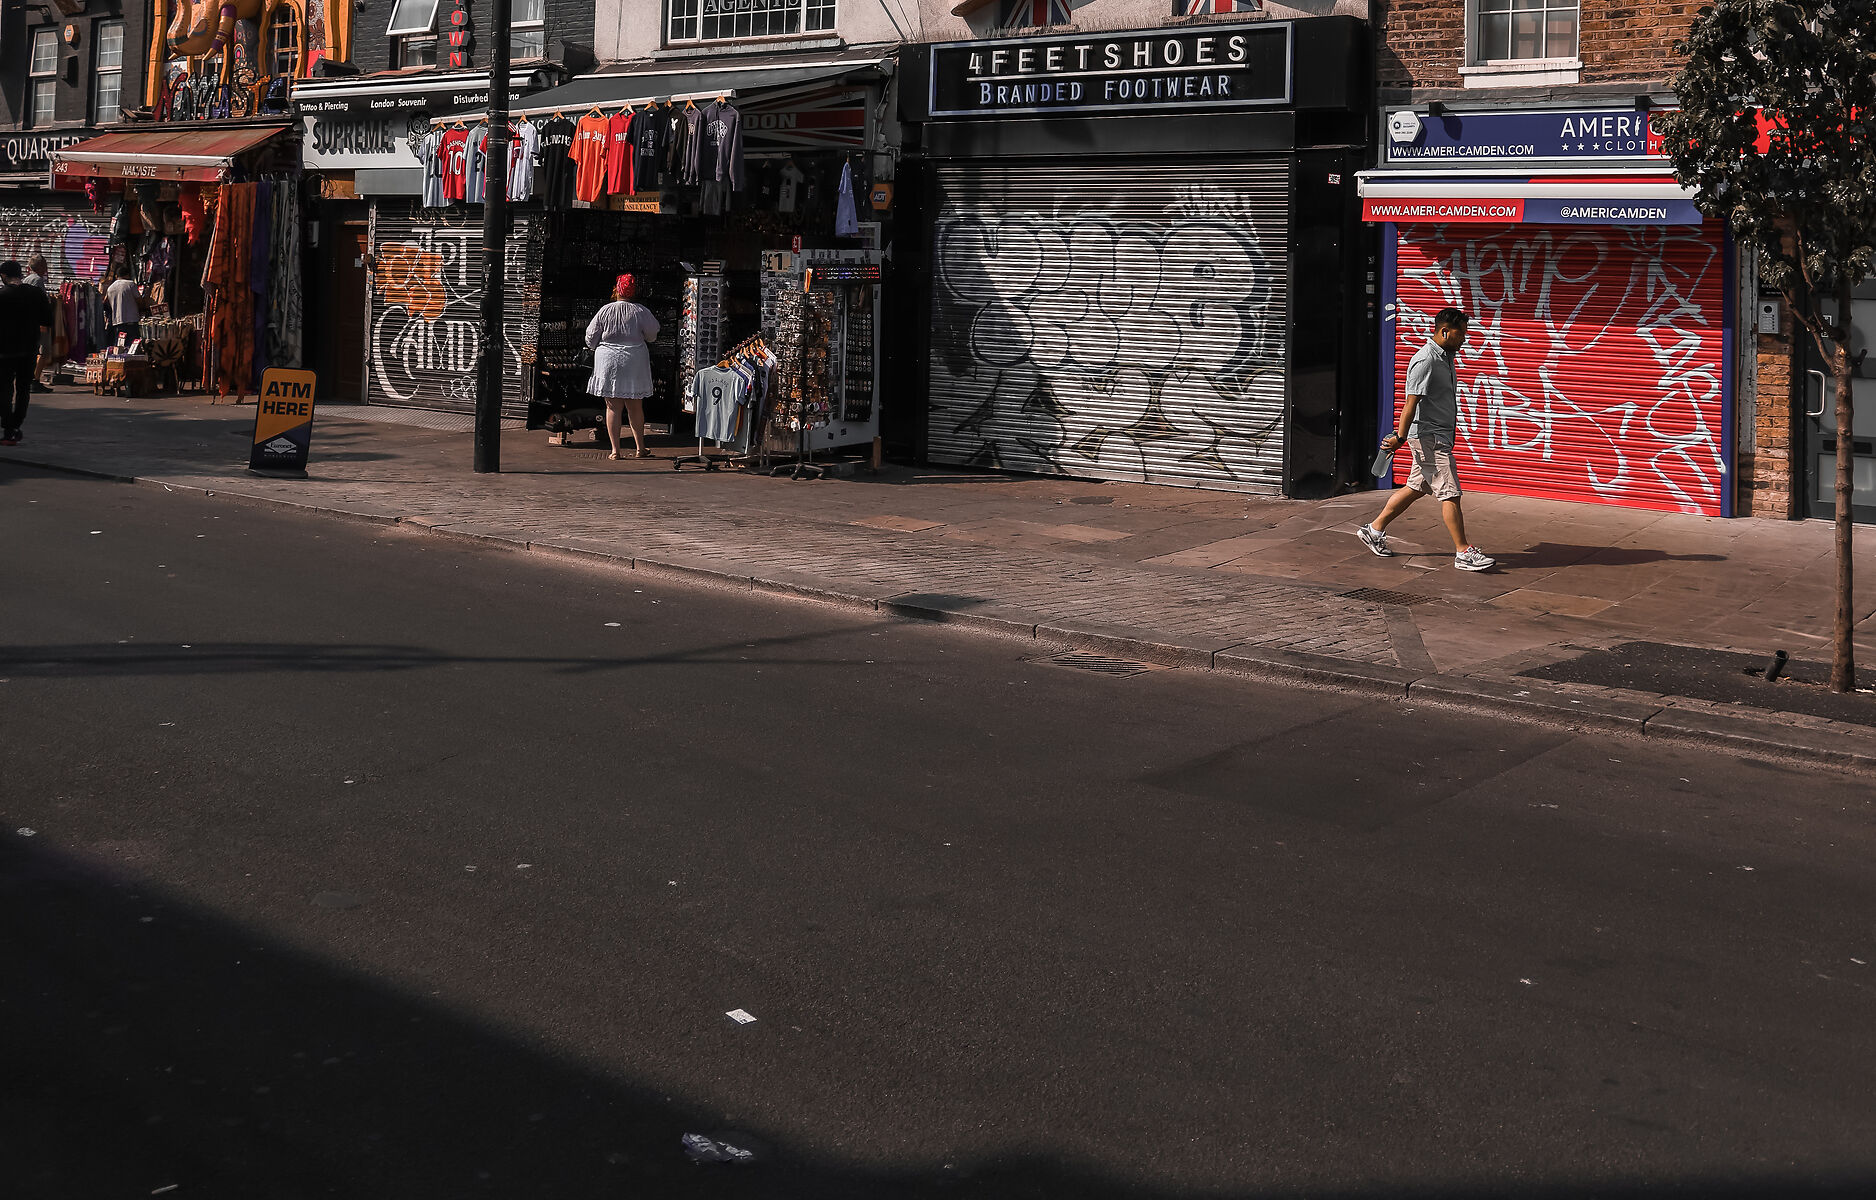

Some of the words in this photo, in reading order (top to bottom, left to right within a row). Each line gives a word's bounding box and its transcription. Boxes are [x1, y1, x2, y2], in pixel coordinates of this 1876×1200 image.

[979, 81, 1083, 105] BRANDED
[1104, 75, 1231, 100] FOOTWEAR
[371, 99, 395, 109] London
[398, 97, 427, 107] Souvenir
[453, 93, 489, 105] Disturbed
[325, 101, 349, 112] Piercing
[312, 120, 396, 154] SUPREME
[1392, 145, 1534, 157] WWW.AMERI-CAMDEN.COM
[55, 162, 68, 173] 243
[448, 150, 463, 176] 10
[121, 165, 157, 177] NAMASTE
[1371, 205, 1517, 217] WWW.AMERI-CAMDEN.COM
[1560, 206, 1667, 219] @AMERICAMDEN
[265, 381, 311, 399] ATM
[711, 386, 723, 406] 9
[263, 400, 309, 416] HERE
